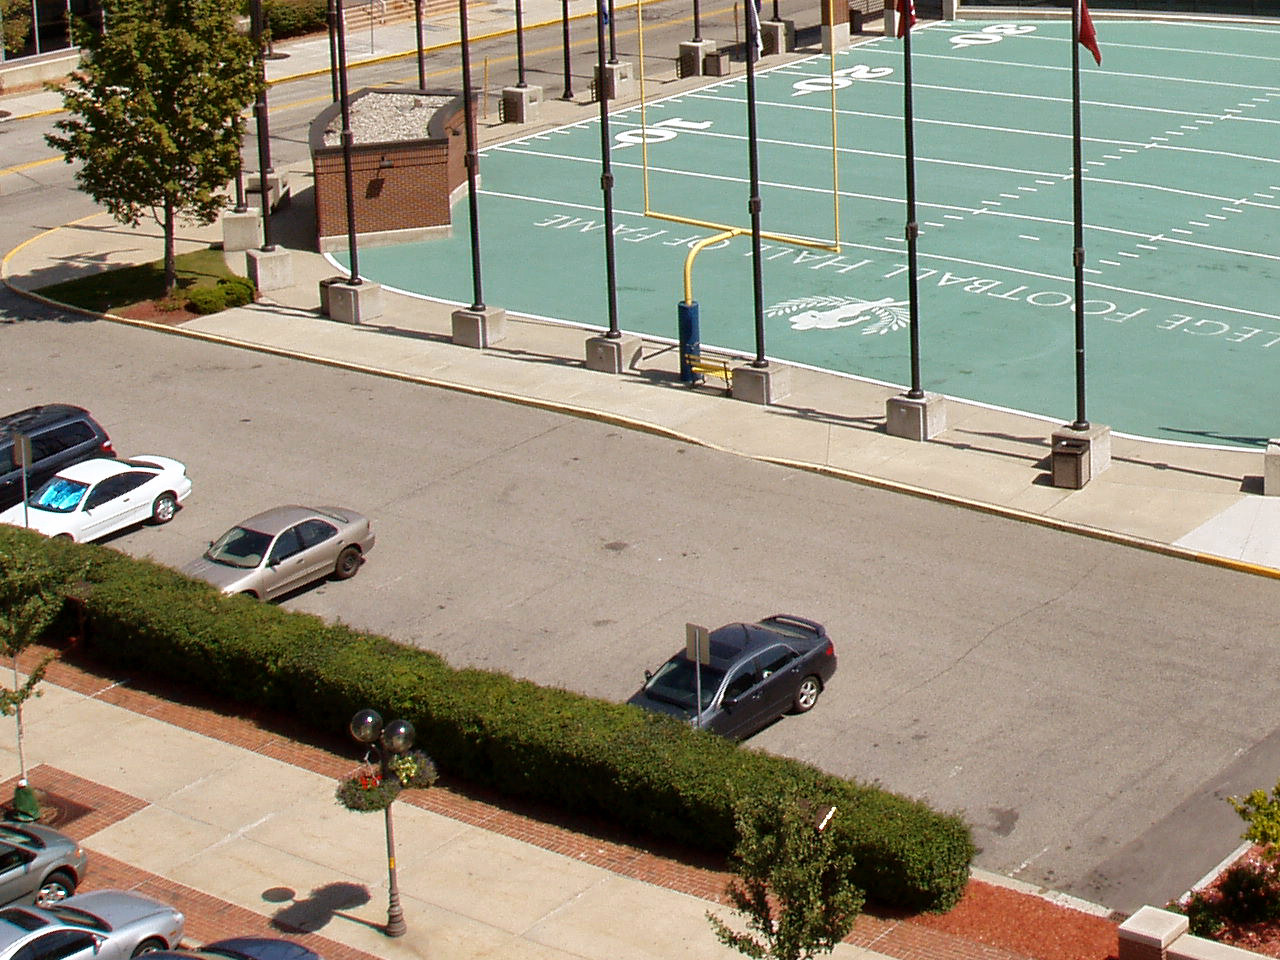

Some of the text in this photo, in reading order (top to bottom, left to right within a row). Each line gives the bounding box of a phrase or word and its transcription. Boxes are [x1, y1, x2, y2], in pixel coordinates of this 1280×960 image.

[949, 23, 1037, 45] 30
[792, 64, 894, 92] 20
[613, 117, 714, 144] 10
[532, 213, 669, 243] FAME
[662, 234, 731, 251] OF
[744, 242, 874, 275] HALL
[883, 262, 1149, 324] FOOTBALL
